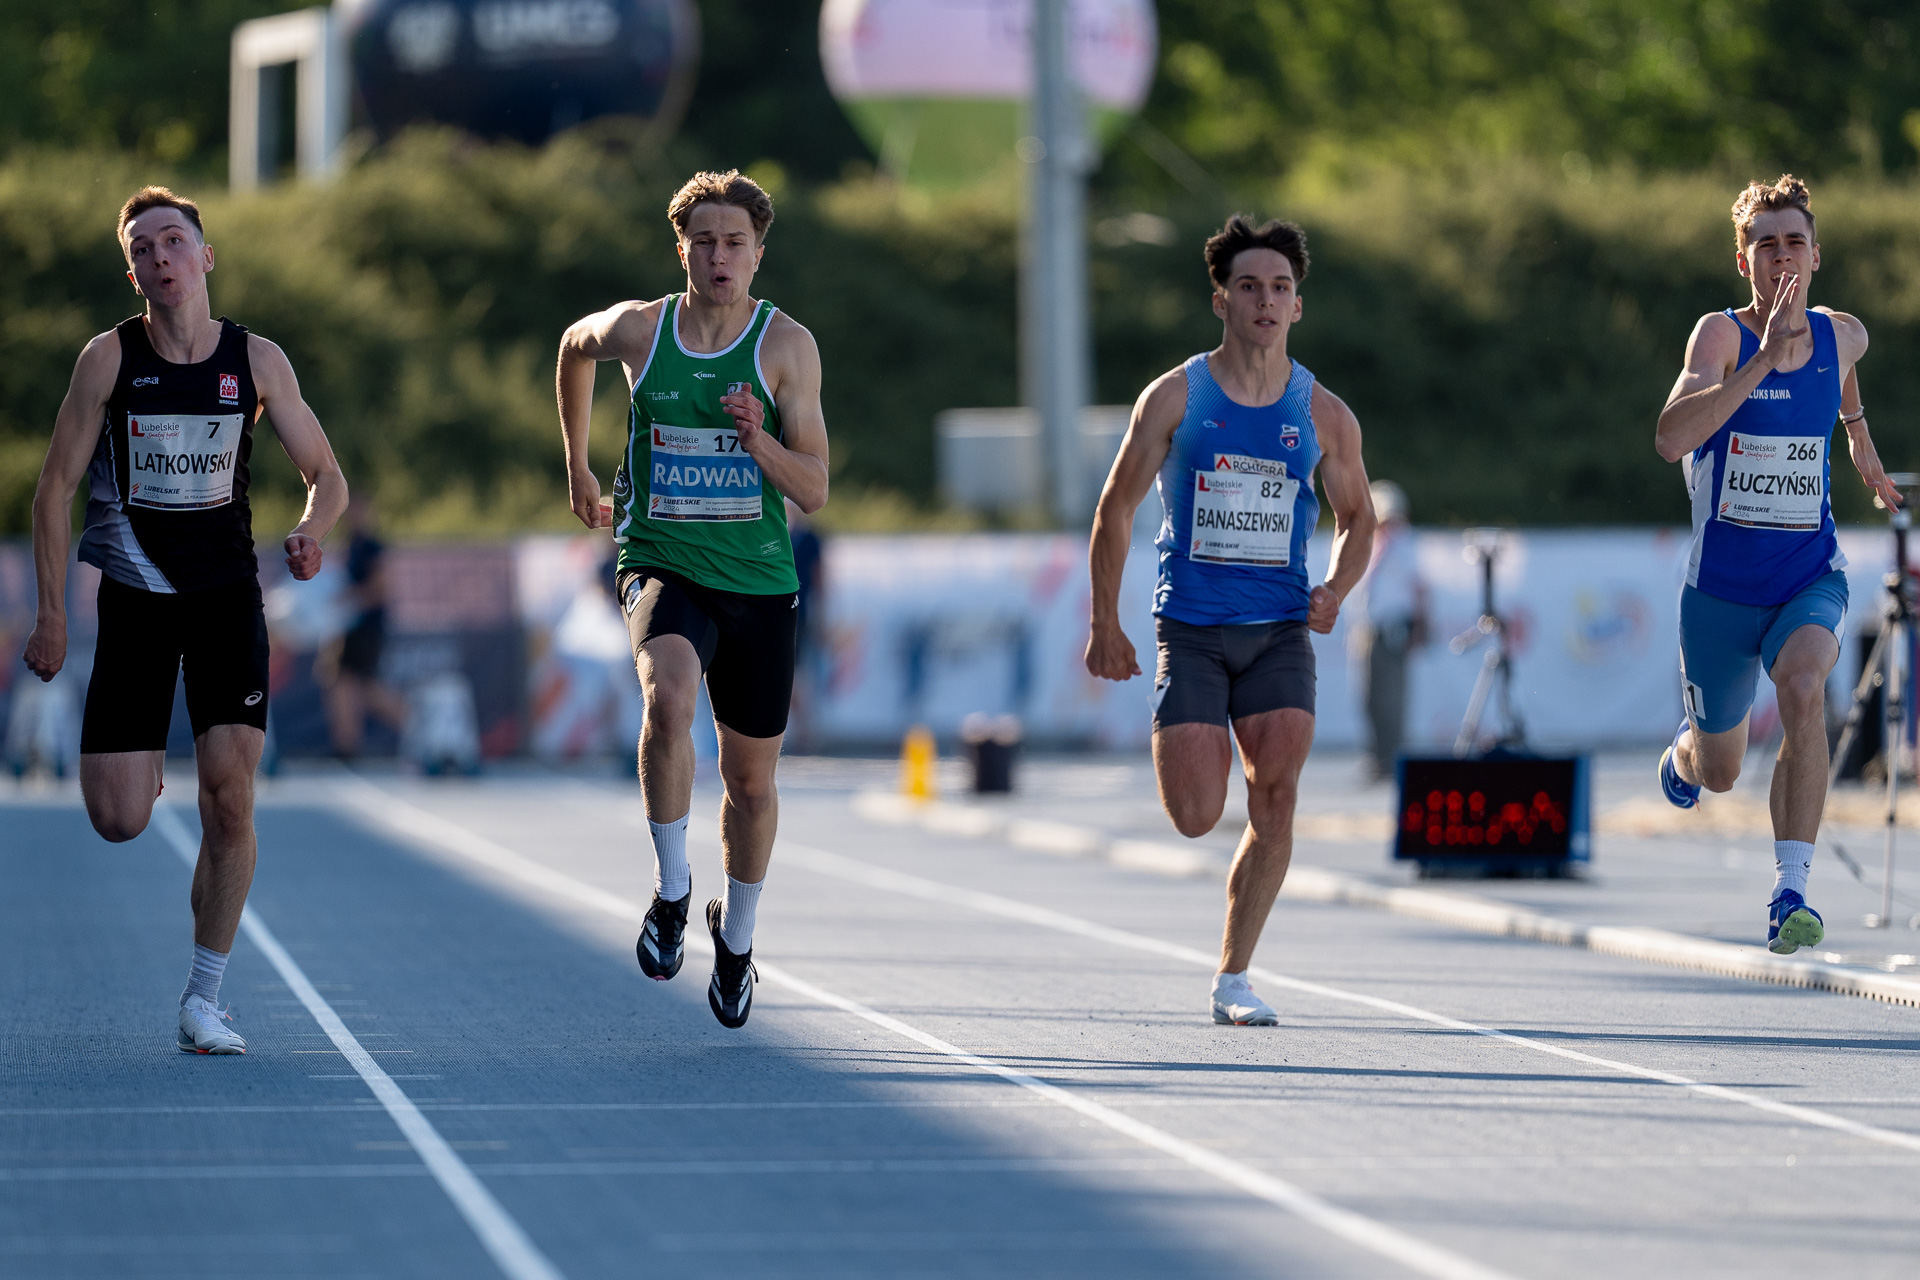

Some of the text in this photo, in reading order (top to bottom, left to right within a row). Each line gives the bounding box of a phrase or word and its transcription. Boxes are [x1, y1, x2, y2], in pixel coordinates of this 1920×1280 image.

[1769, 389, 1791, 400] RAWA
[207, 421, 221, 439] 7
[1786, 442, 1817, 461] 266
[134, 450, 233, 475] LATKOWSKI
[653, 462, 759, 488] RADWAN
[143, 484, 180, 495] LUBELSKIE
[1260, 480, 1283, 499] 82
[1728, 470, 1820, 496] ŁUCZYŃSKI
[143, 490, 160, 500] 2024
[663, 497, 701, 506] LUBELSKIE
[663, 504, 680, 512] 2024
[1732, 510, 1750, 518] 2024
[1733, 503, 1771, 514] LUBELSKIE
[1196, 507, 1290, 533] BANASZEWSKI
[1205, 540, 1240, 550] LUBELSKIE
[1686, 684, 1697, 713] 1
